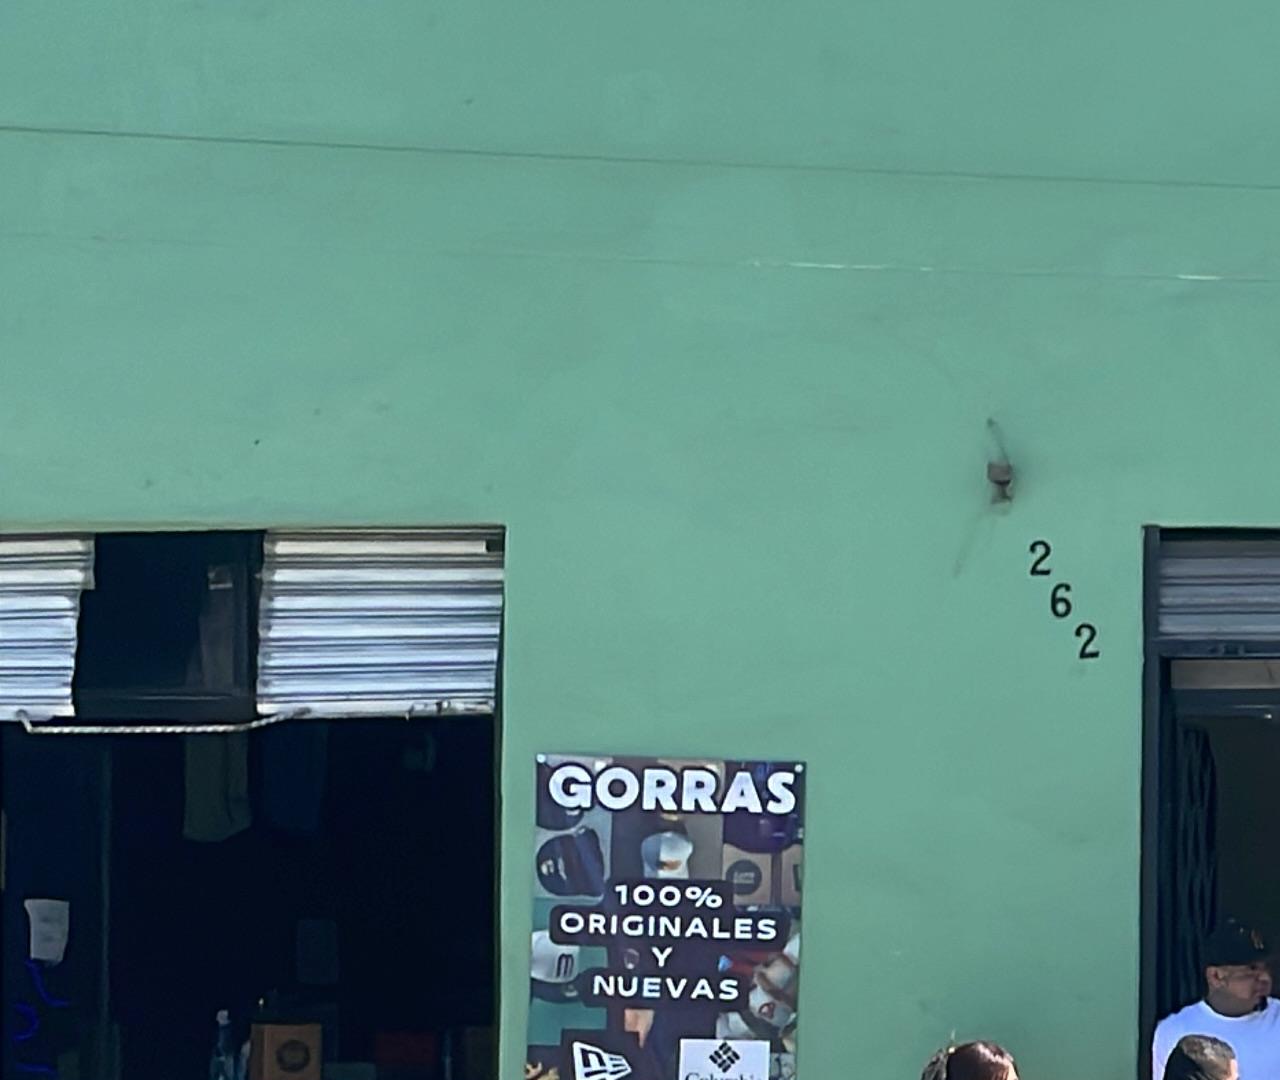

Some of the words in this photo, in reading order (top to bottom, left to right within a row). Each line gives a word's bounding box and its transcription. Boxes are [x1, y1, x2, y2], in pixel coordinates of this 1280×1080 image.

[1030, 540, 1100, 659] 262
[548, 765, 796, 815] GORRAS
[614, 884, 723, 908] 100%
[560, 912, 777, 940] ORIGINALES
[651, 947, 673, 968] Y
[593, 975, 739, 1000] NUEVAS
